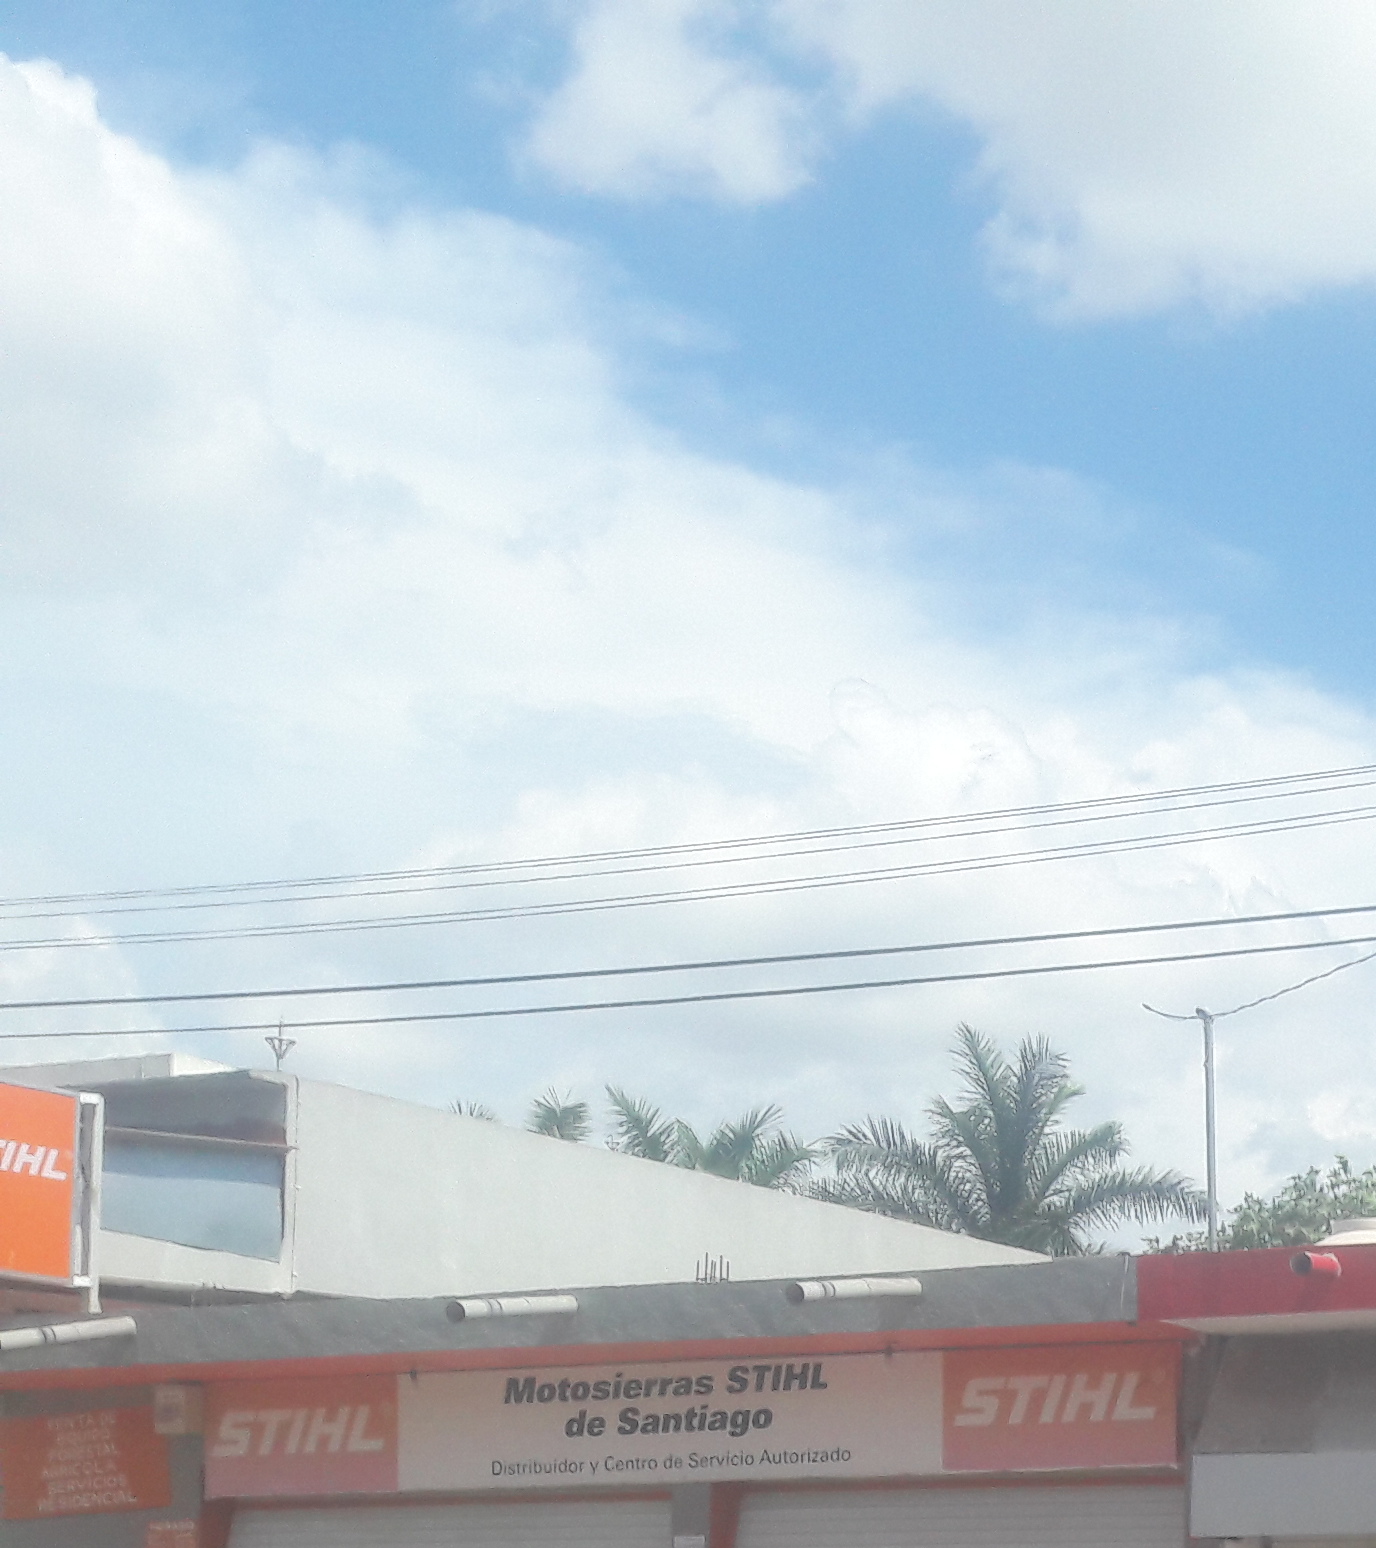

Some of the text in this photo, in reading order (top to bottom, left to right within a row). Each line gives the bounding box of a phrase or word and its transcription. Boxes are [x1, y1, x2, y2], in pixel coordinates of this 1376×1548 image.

[504, 1363, 828, 1404] Motosierras STIHL
[954, 1371, 1157, 1427] STIHL
[211, 1404, 385, 1457] STIHL
[565, 1405, 774, 1438] de Santiago
[491, 1447, 852, 1477] Distribuidor y Centro de Servicio Autorizado
